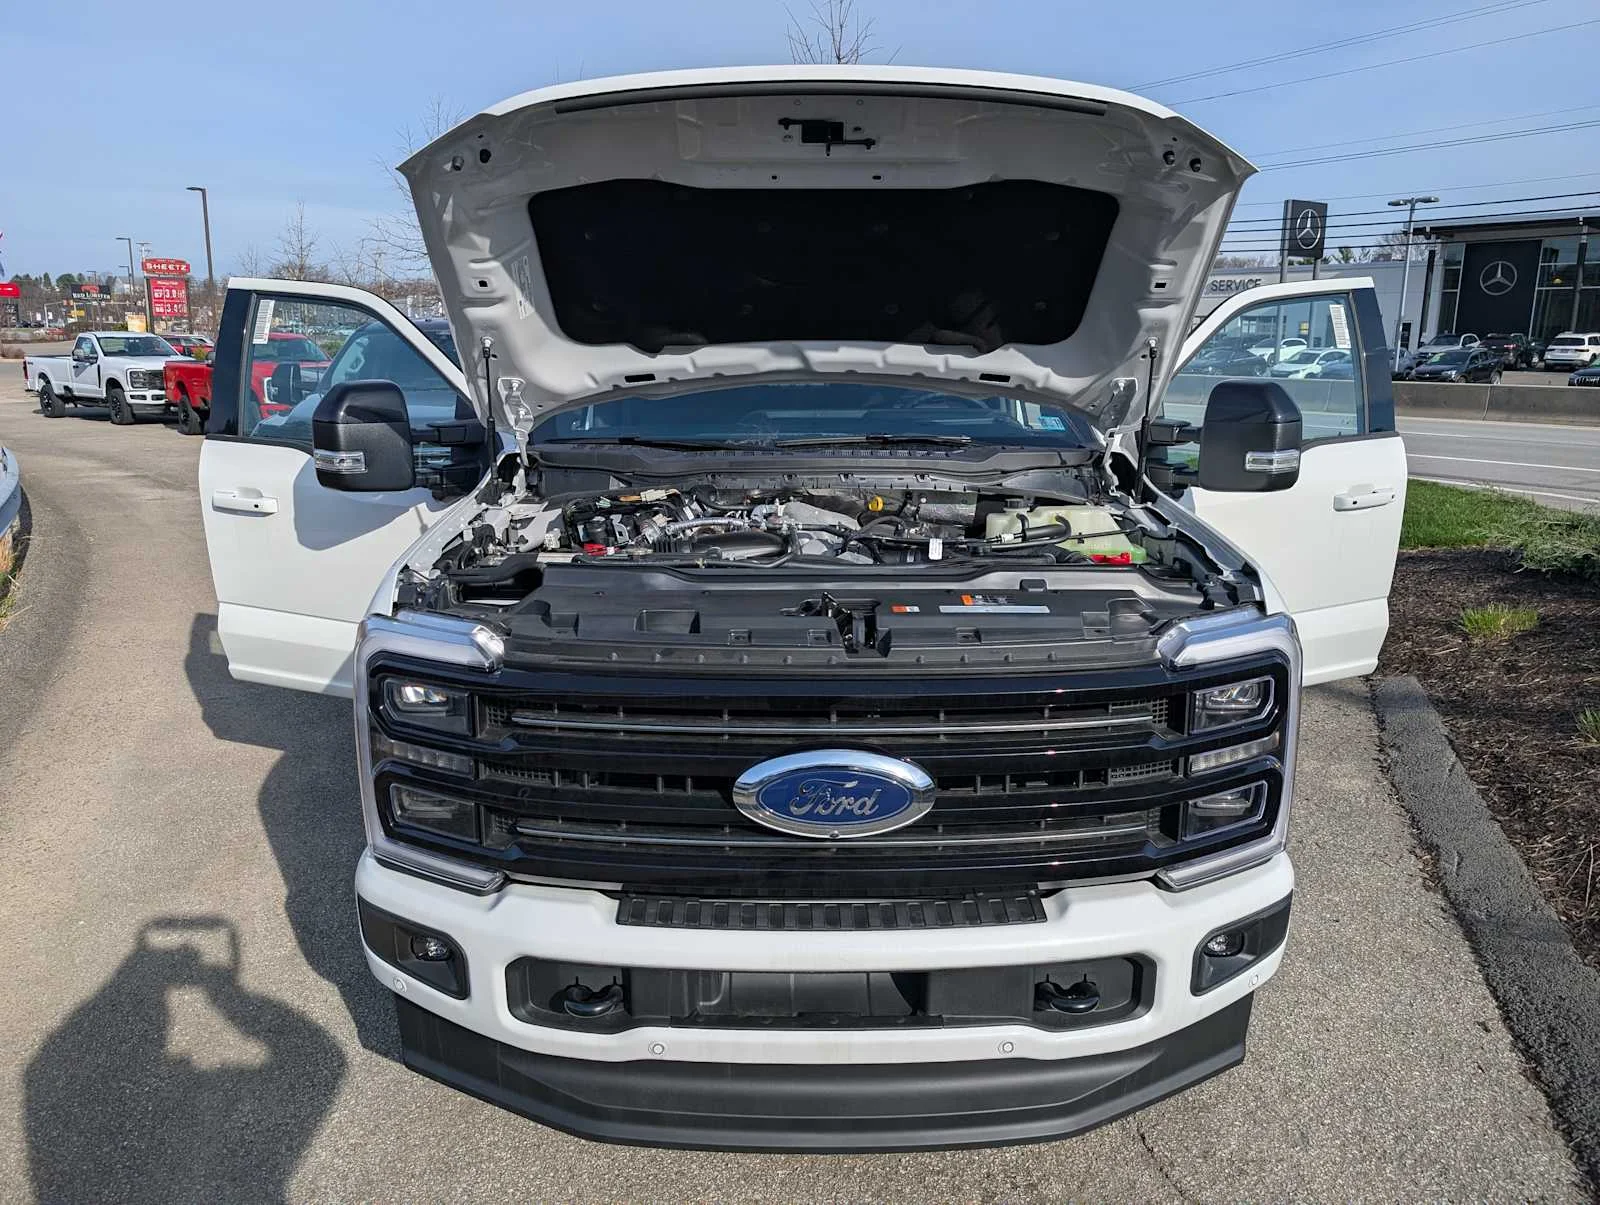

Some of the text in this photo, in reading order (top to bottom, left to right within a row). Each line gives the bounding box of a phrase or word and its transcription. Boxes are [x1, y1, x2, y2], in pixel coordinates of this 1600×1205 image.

[146, 262, 187, 271] SHEETZ
[1210, 278, 1262, 292] SERVICE
[788, 778, 882, 816] Ford
